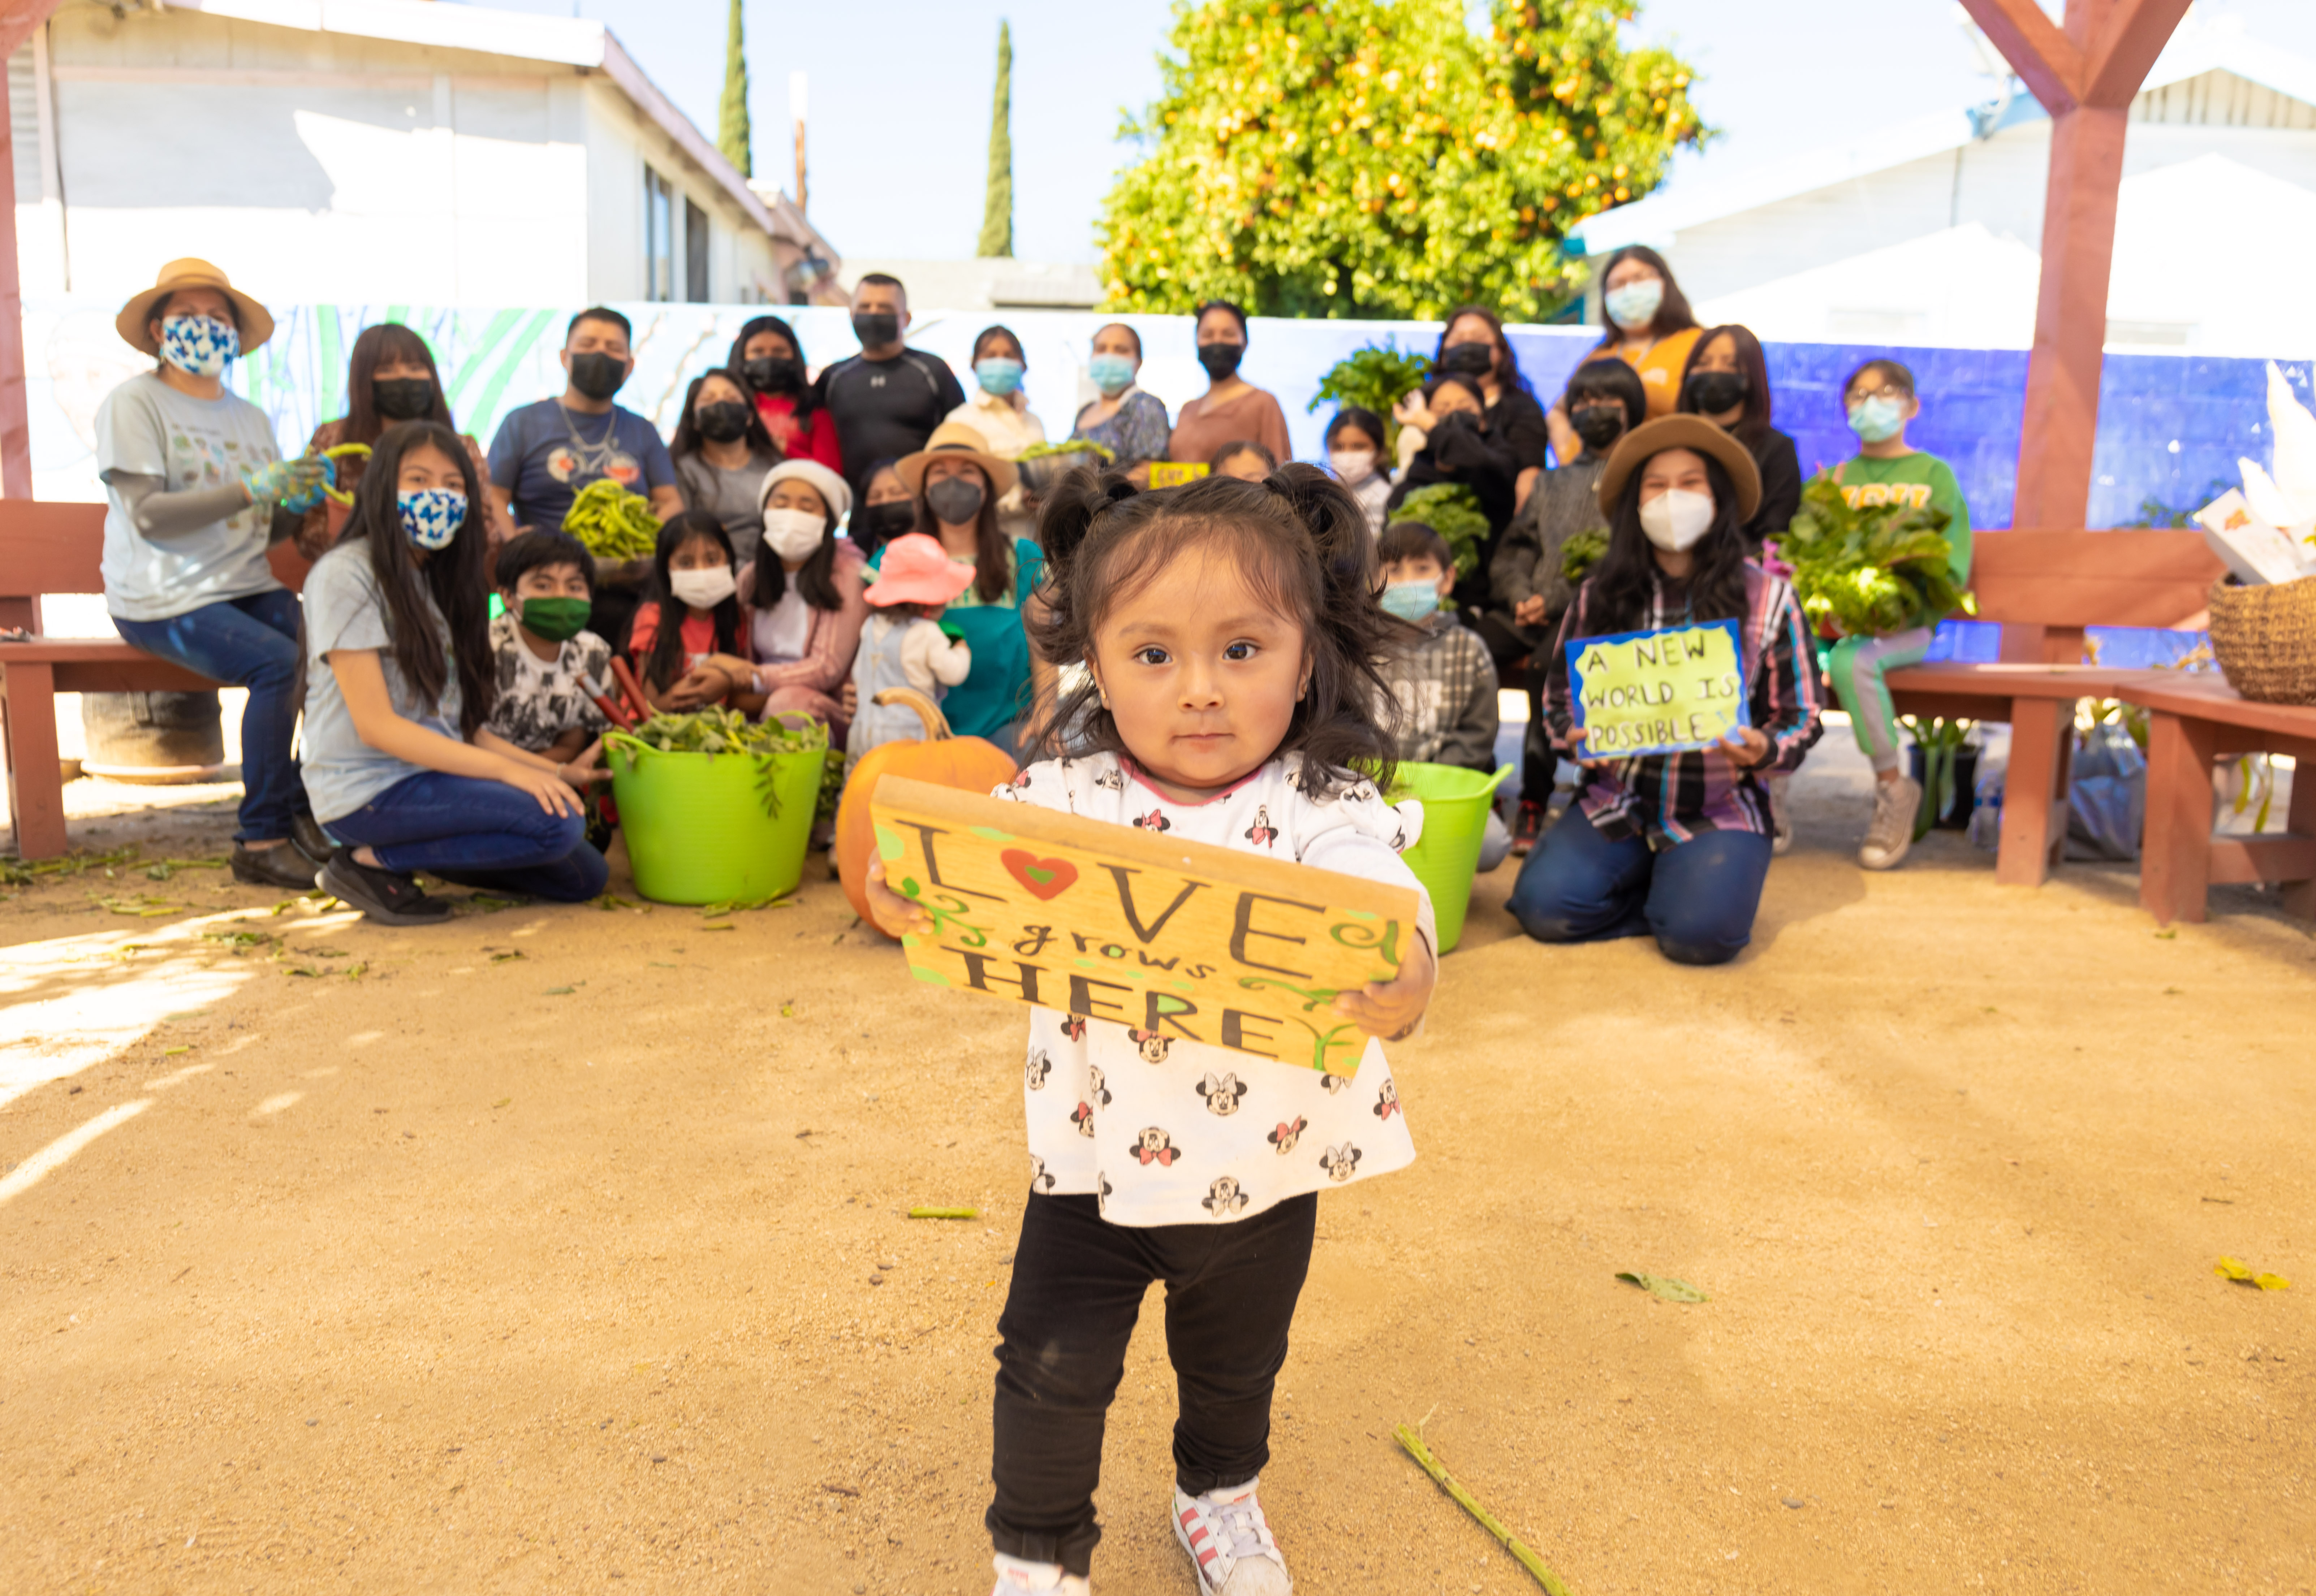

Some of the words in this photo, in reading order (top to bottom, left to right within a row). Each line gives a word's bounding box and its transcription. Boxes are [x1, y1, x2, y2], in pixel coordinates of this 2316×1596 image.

[1588, 650, 1608, 673] A
[1635, 633, 1705, 668] NEW
[1585, 682, 1673, 708] WORLD
[1697, 673, 1735, 699] IS
[1590, 713, 1707, 751] POSSIBLE
[1014, 925, 1217, 979] grows
[940, 945, 1284, 1059] HERE
